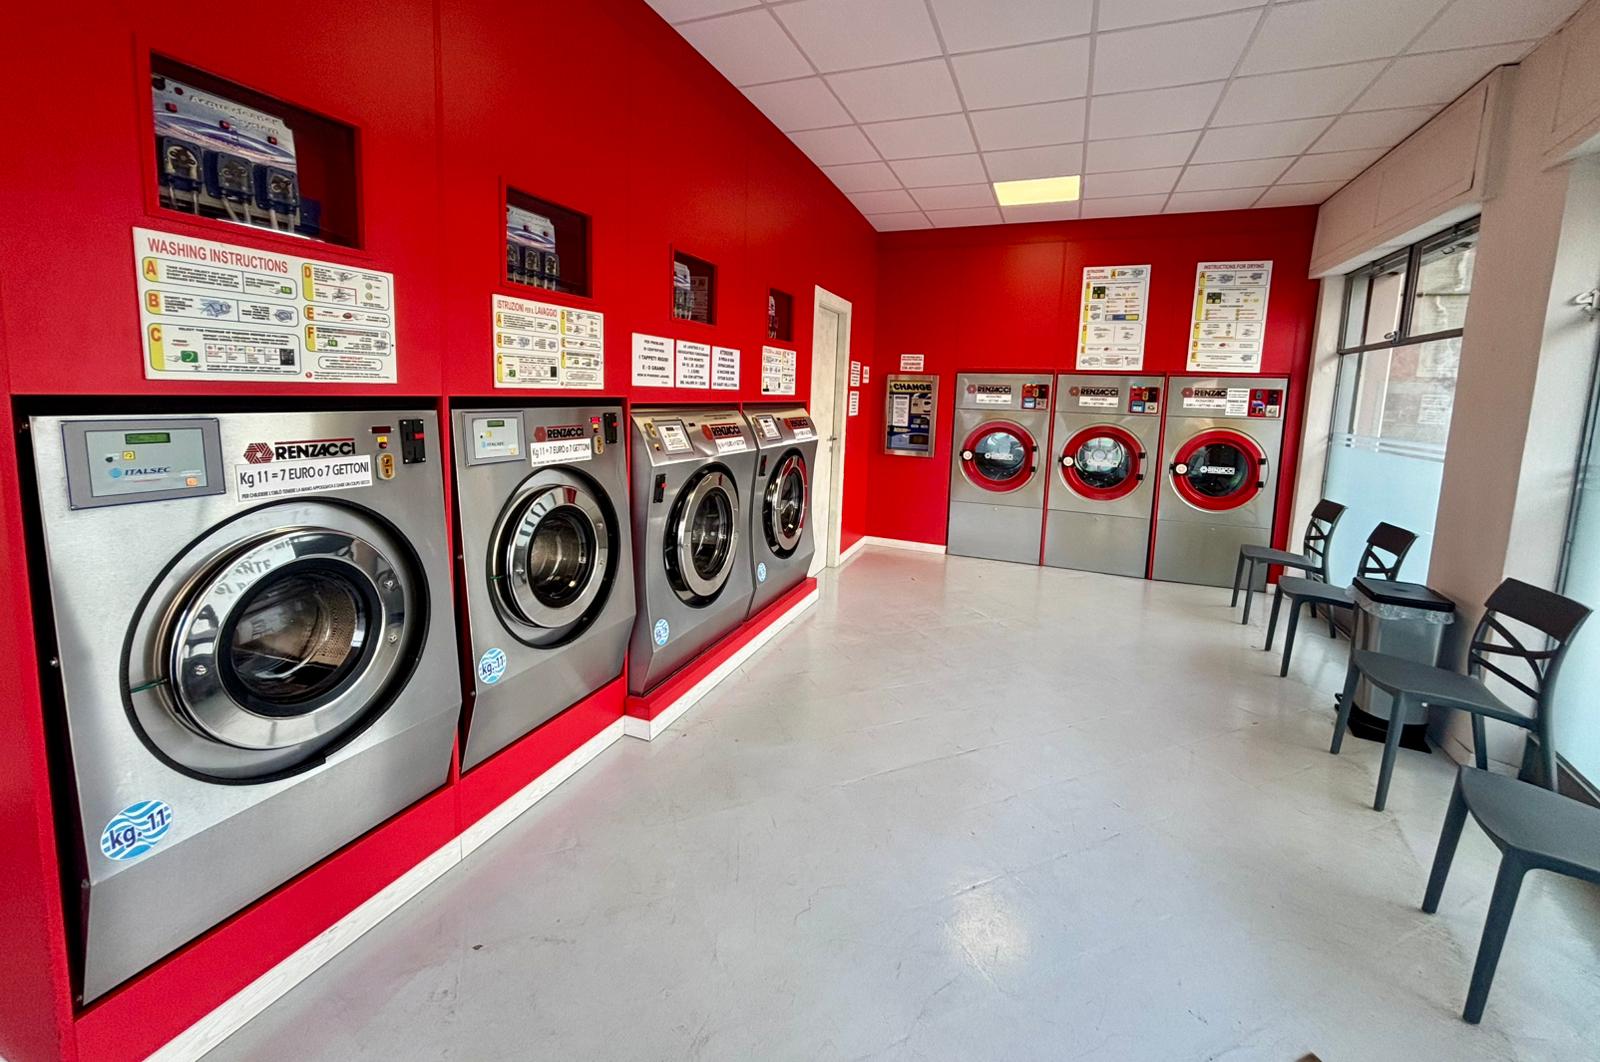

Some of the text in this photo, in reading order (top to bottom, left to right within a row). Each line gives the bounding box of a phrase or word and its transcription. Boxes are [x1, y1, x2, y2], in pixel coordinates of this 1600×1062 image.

[148, 238, 288, 274] WASHING INSTRUCTIONS
[146, 261, 156, 275] A
[304, 266, 311, 278] D
[148, 293, 159, 307] B
[307, 307, 314, 320] E
[497, 300, 524, 312] ISTRUZIONI
[535, 305, 557, 317] LAVAGGIO
[150, 327, 161, 342] C
[308, 327, 314, 339] F
[547, 428, 584, 438] RENZACCI
[711, 425, 741, 436] RENZACCI
[275, 442, 356, 460] RENZACCI
[533, 448, 539, 458] Kg
[553, 445, 565, 454] EURO
[125, 466, 171, 476] ITALSEC
[240, 472, 254, 488] Kg
[258, 470, 268, 483] 11
[281, 469, 286, 481] 7
[289, 466, 315, 480] EURO
[317, 468, 323, 477] o
[325, 465, 330, 476] 7
[332, 462, 369, 476] GETTONI
[496, 656, 504, 668] 11
[109, 808, 165, 849] kg. 11
